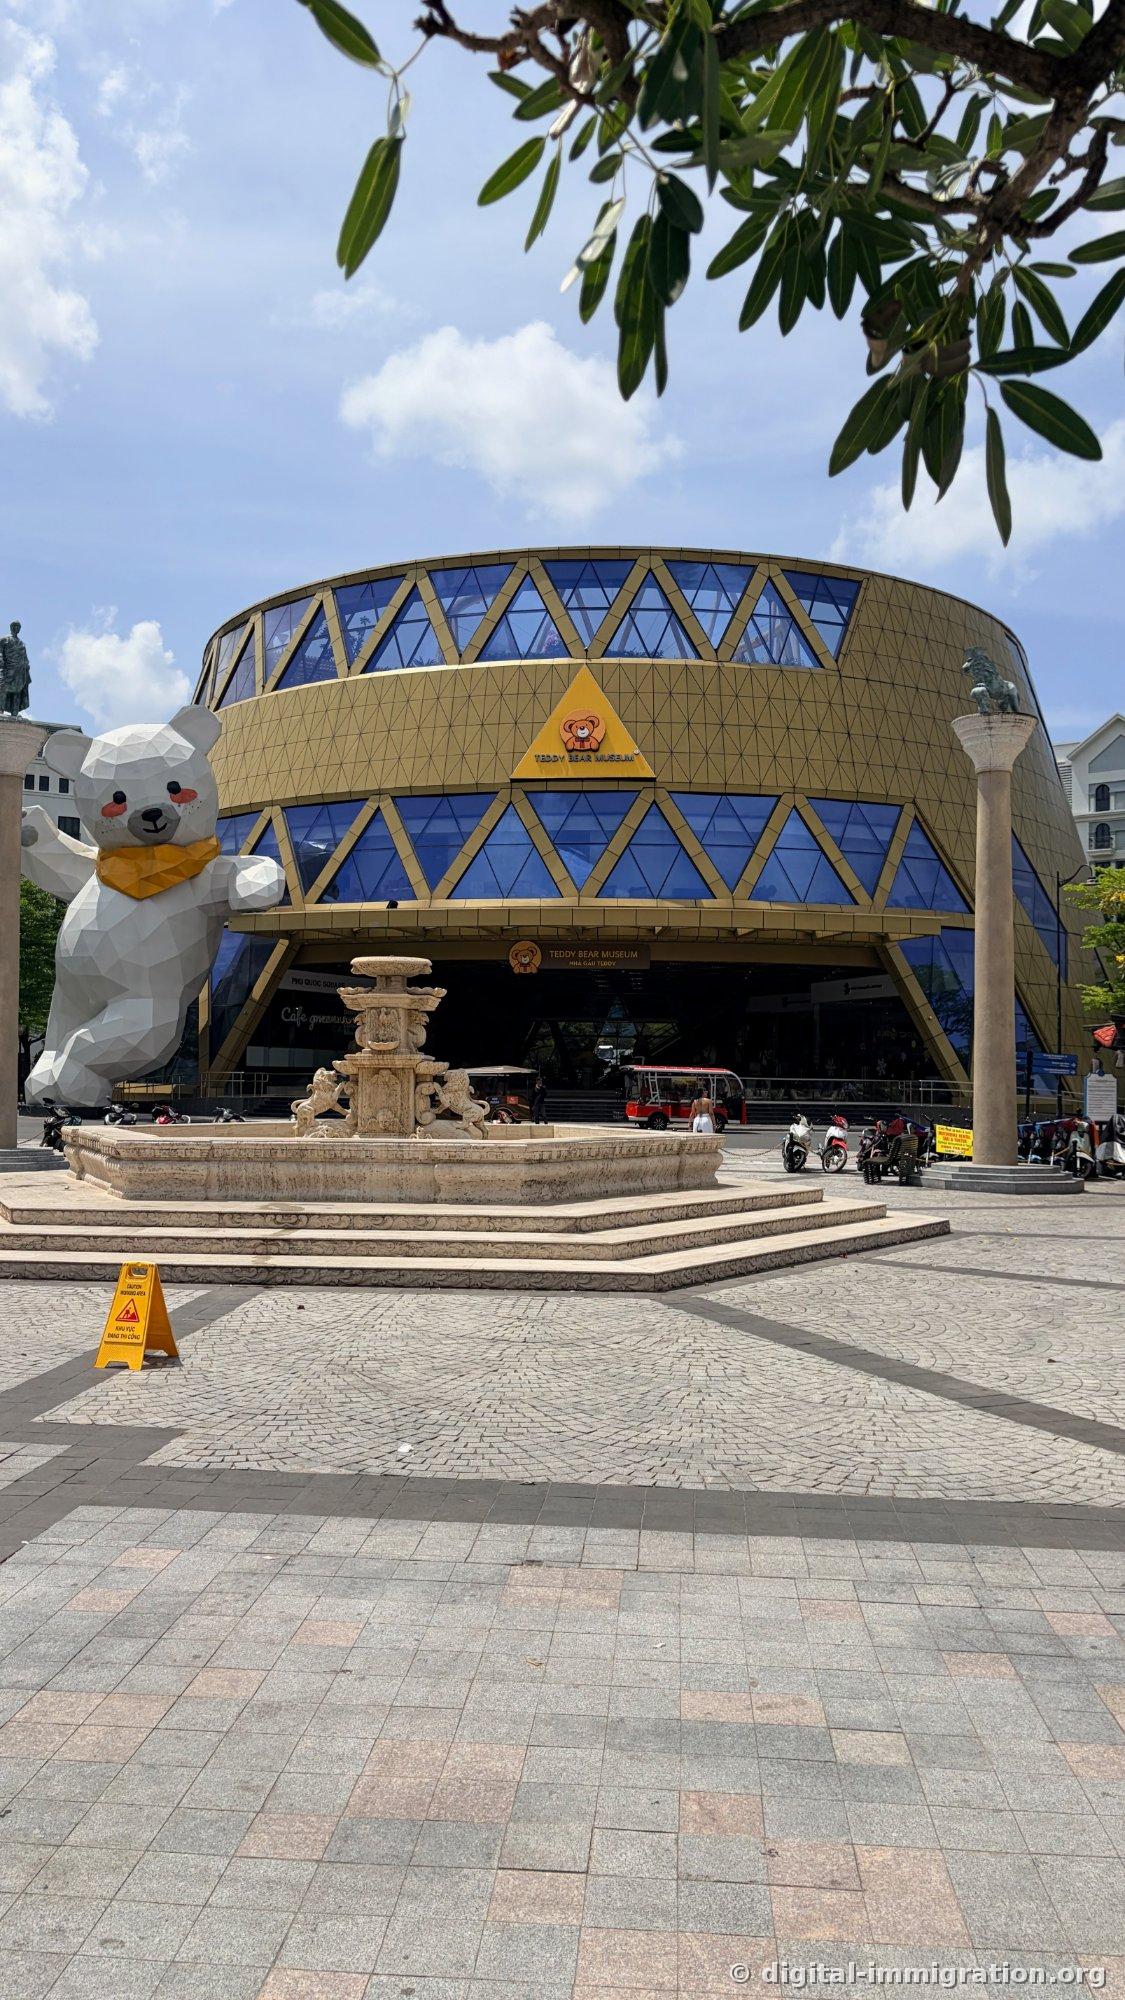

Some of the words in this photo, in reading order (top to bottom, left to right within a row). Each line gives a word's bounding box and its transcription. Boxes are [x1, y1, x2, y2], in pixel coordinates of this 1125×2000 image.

[534, 754, 565, 763] TEDDY
[568, 754, 592, 762] BEAR
[595, 754, 635, 762] MUSEUM
[549, 950, 577, 958] TEDDY
[579, 950, 599, 958] BEAR
[601, 950, 638, 958] MUSEUM
